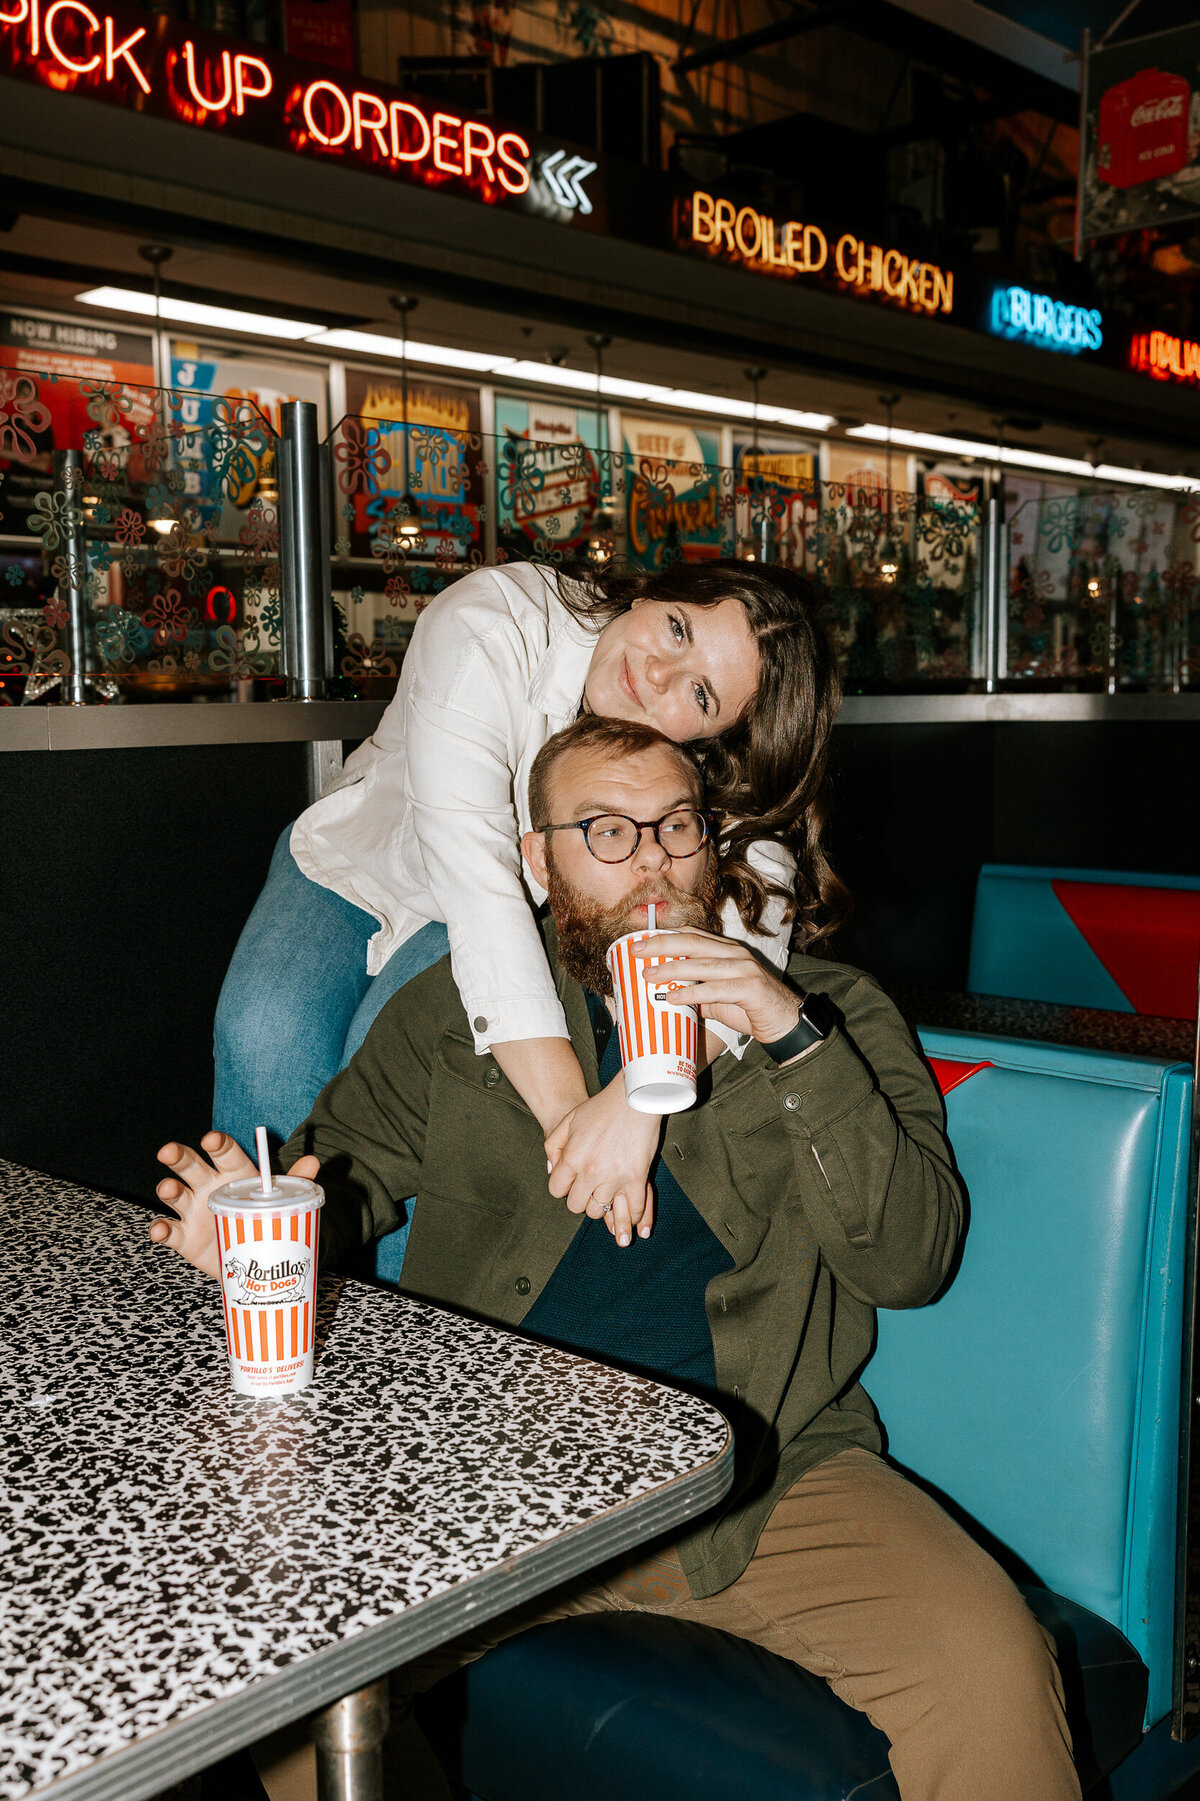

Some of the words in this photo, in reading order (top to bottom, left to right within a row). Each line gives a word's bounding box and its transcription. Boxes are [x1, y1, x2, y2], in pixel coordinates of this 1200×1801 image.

[184, 41, 273, 116] UP
[303, 80, 531, 194] ORDERS
[1130, 95, 1184, 128] Coca-Cola
[692, 190, 828, 274] BROILED
[835, 233, 954, 315] CHICKEN
[10, 318, 52, 341] NOW
[55, 324, 118, 351] HIRING
[1008, 286, 1103, 351] BURGERS
[246, 1279, 267, 1292] HOT
[270, 1277, 297, 1291] DOGS
[247, 1258, 306, 1281] Portillo's
